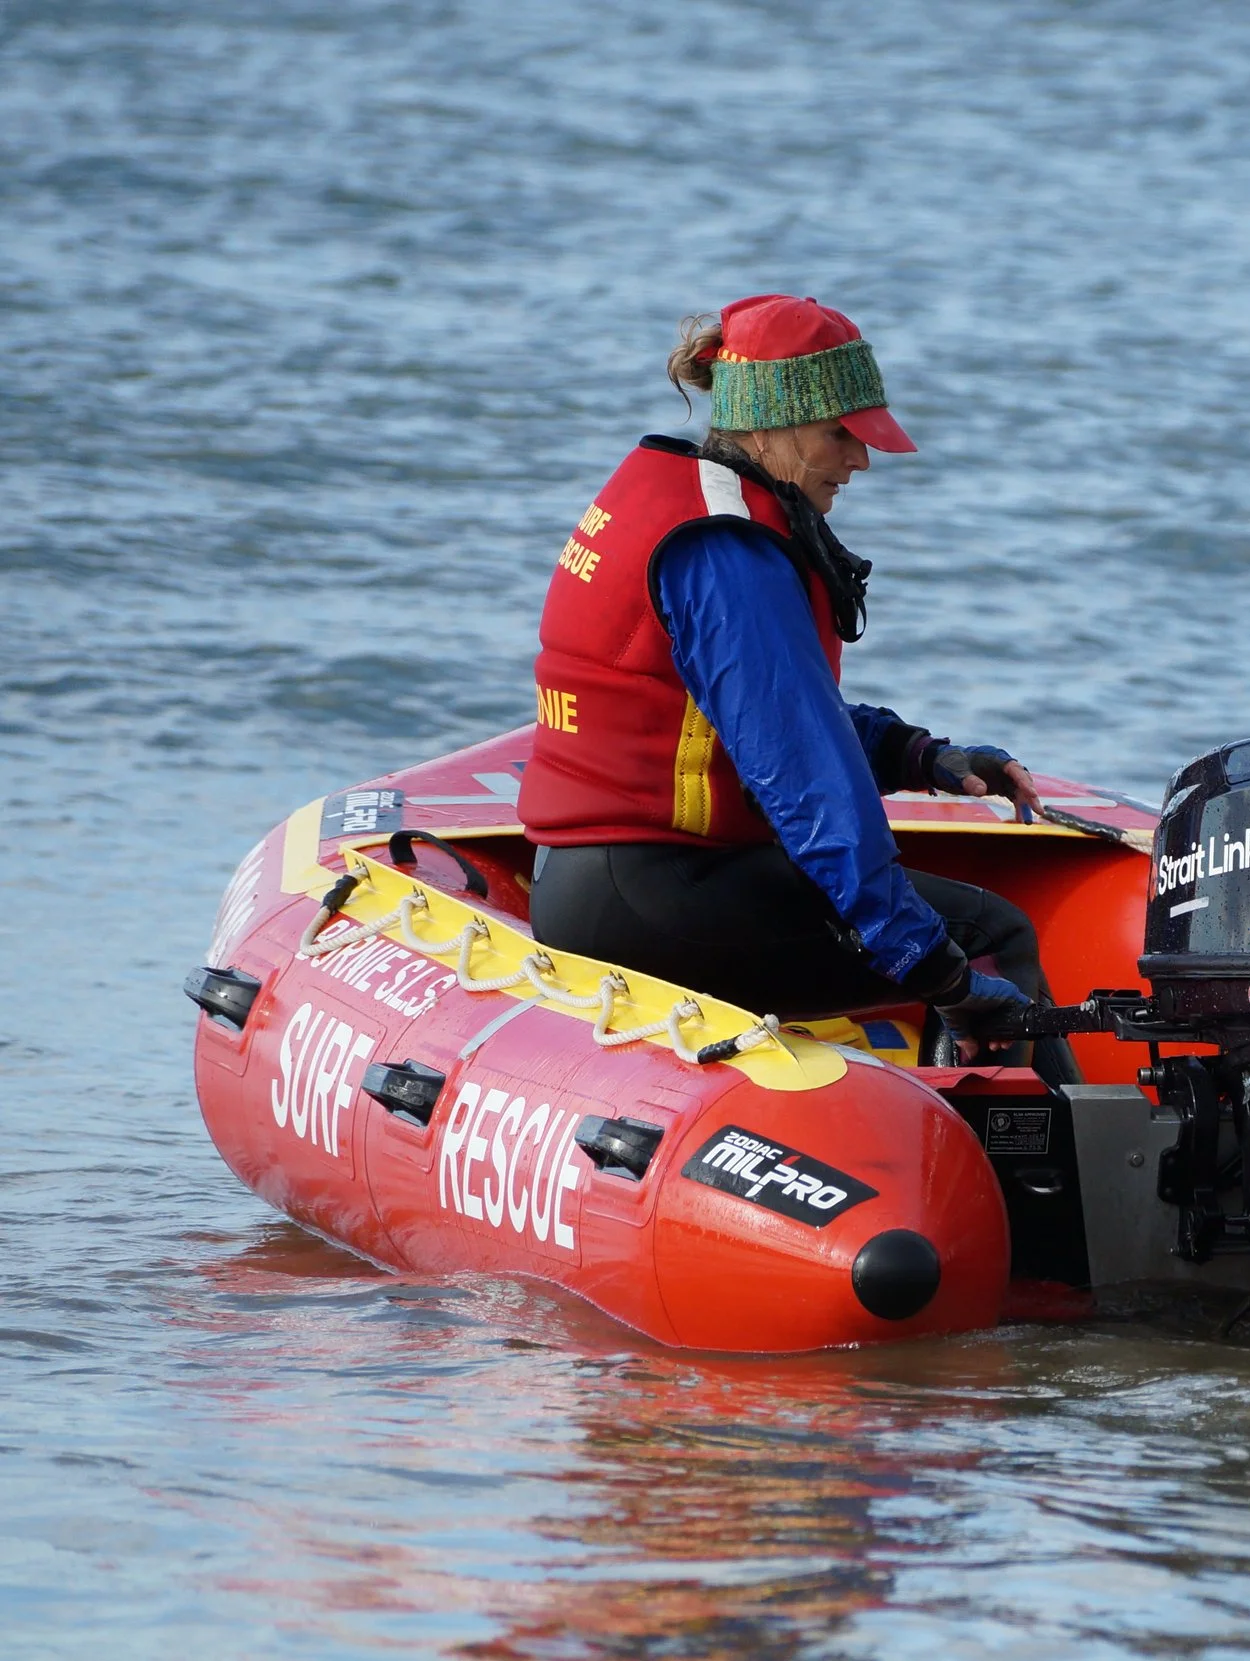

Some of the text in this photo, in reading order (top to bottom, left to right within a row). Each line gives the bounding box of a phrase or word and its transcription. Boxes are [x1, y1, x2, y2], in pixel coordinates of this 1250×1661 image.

[578, 502, 613, 538] URF
[536, 683, 579, 734] NIE
[1158, 841, 1206, 896] Strait
[271, 1002, 581, 1251] SURF RESCUE
[723, 1131, 784, 1161] ZODIAC
[701, 1141, 848, 1210] MILPRO
